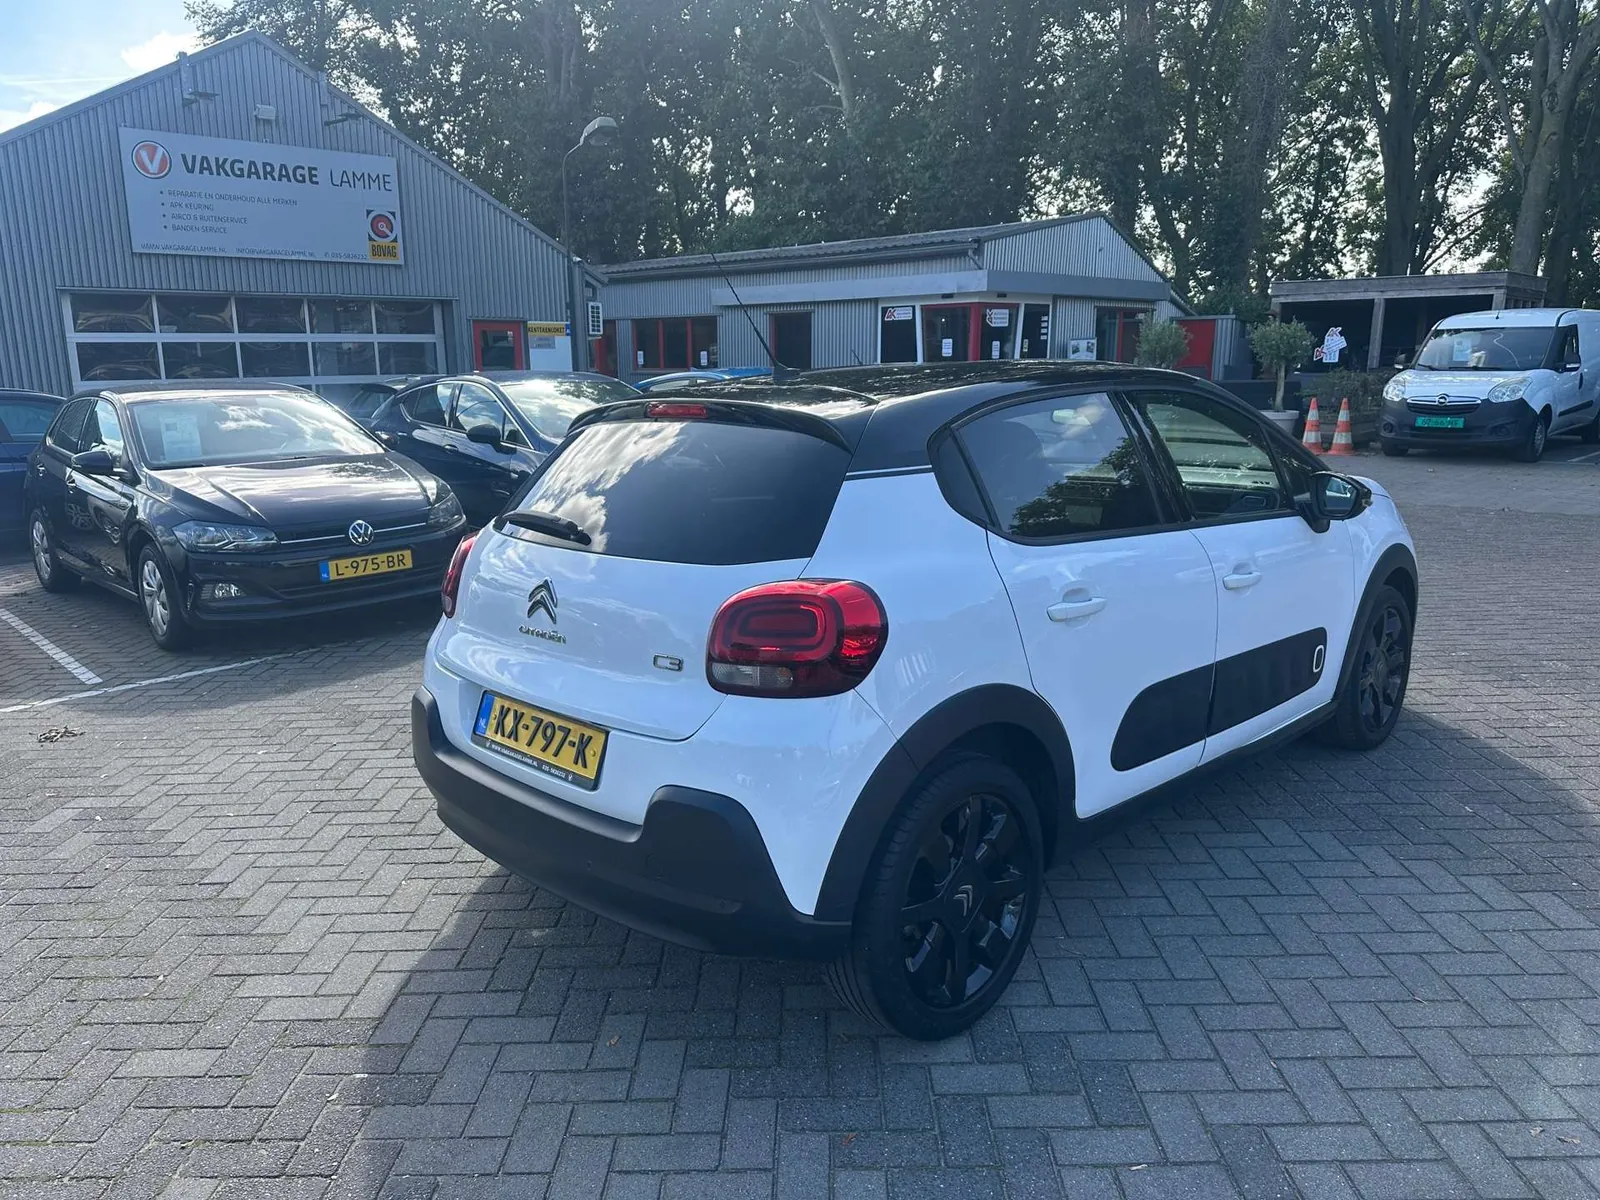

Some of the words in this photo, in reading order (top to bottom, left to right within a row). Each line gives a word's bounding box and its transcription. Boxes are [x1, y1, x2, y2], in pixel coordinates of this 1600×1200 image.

[181, 153, 319, 185] VAKGARAGE
[330, 168, 392, 192] LAMME
[168, 189, 202, 199] REPARATIE
[215, 193, 255, 203] ONDERHOUD
[257, 196, 272, 204] ALLE
[273, 198, 298, 206] MERKEN
[169, 201, 184, 209] APK
[185, 202, 214, 211] KEURING
[171, 213, 192, 221] AIRCO
[199, 214, 248, 224] RUITENSERVICE
[172, 224, 200, 233] BANDEN
[201, 226, 227, 234] SERVICE
[371, 243, 397, 258] BOVAG
[335, 553, 406, 577] L-975-BR
[653, 654, 684, 672] C3
[493, 704, 593, 770] KX-797-K
